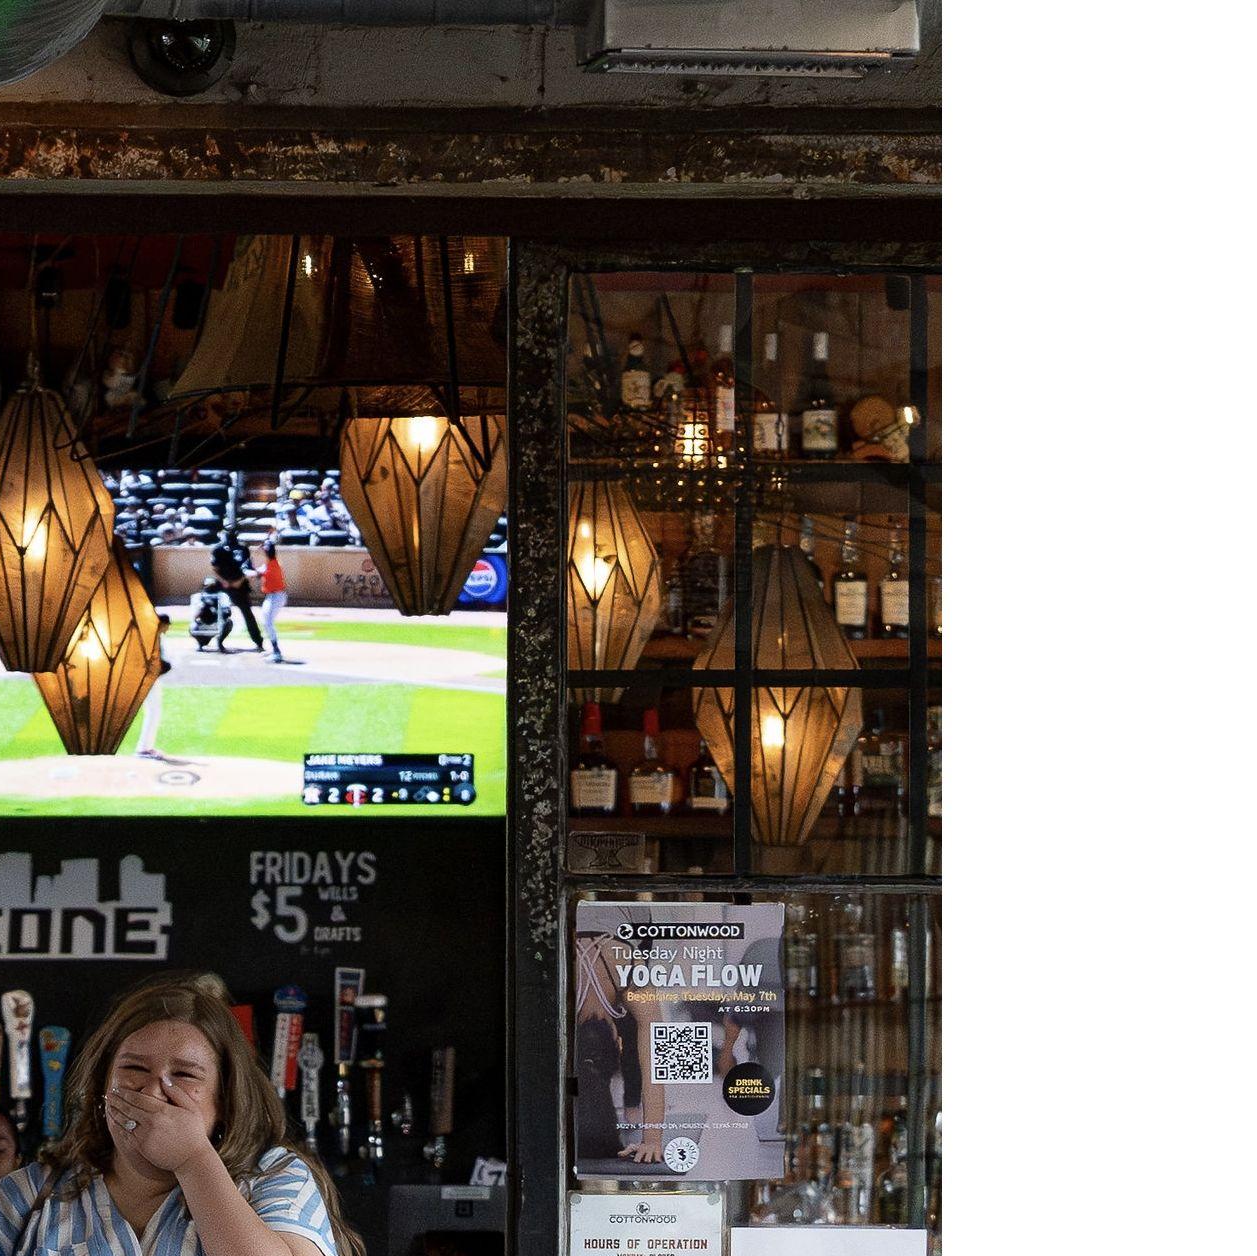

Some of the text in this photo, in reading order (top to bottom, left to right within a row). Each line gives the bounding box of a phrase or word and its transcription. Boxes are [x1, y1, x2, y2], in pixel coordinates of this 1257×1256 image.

[306, 755, 336, 766] JAKE
[328, 787, 384, 803] 2 2
[249, 851, 376, 884] FRIDAYS
[250, 886, 308, 943] $5
[314, 926, 362, 941] DRAFTS
[637, 926, 740, 937] COTTONWOOD
[612, 946, 724, 963] Tuesday Night
[616, 964, 763, 987] YOGA FLOW
[626, 991, 777, 1004] Beginning Tuesday, May 7th
[734, 1005, 770, 1013] 6:30PM
[728, 1086, 771, 1095] SPECIALS
[609, 1214, 677, 1224] COTTONWOOD
[584, 1239, 708, 1249] HOURS OF OPERATION
